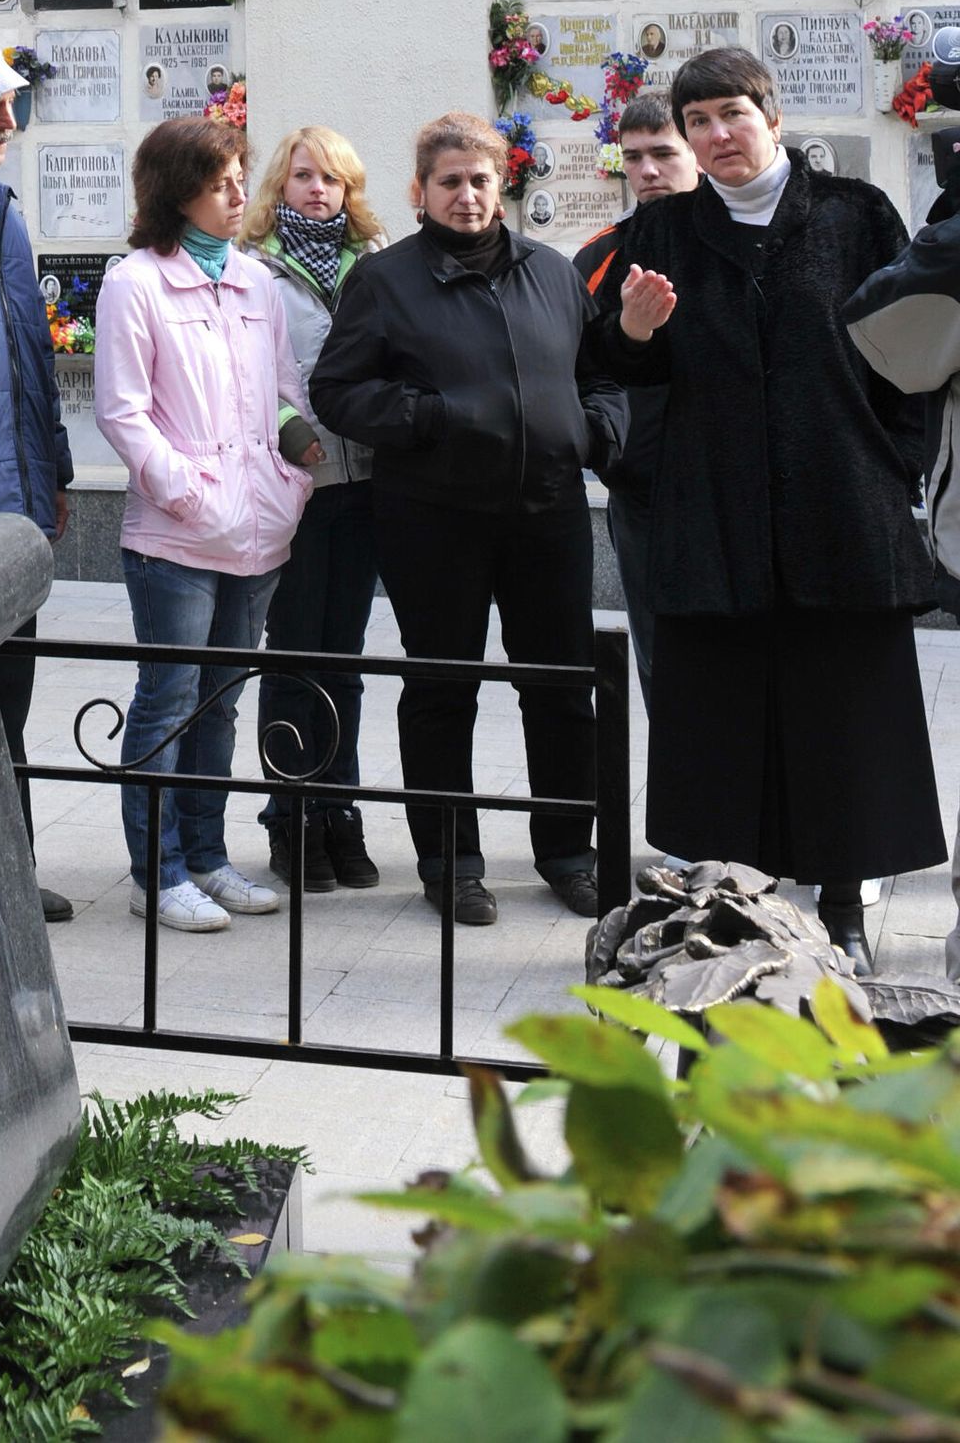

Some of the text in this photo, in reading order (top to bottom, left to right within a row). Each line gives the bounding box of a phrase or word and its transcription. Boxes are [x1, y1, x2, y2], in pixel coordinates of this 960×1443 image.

[801, 17, 850, 30] ПИНЧУК
[155, 28, 228, 44] КАДЫКОВЫ
[809, 32, 841, 43] ЕЛЕНА
[51, 45, 106, 62] КАЗАКОВА
[145, 44, 224, 57] СЕРГЕЙ АЛЕКСЕЕВИЧ
[800, 44, 855, 54] НИКОЛАЕВНА
[73, 64, 117, 79] ГЕНРИХОВНА
[777, 69, 847, 82] МАРГОЛИН
[171, 87, 199, 98] ГАЛИНА
[810, 82, 856, 94] ГРИГОРЬЕВИЧ
[561, 144, 600, 154] КРУГЛО
[45, 154, 117, 173] КАПИТОНОВА
[42, 174, 121, 190] ОЛЬГА НИКОЛАЕВНА
[55, 192, 108, 206] 1897 1982
[558, 192, 617, 202] КРУГЛОВА
[45, 257, 103, 265] МИХАЙЛОВЫ
